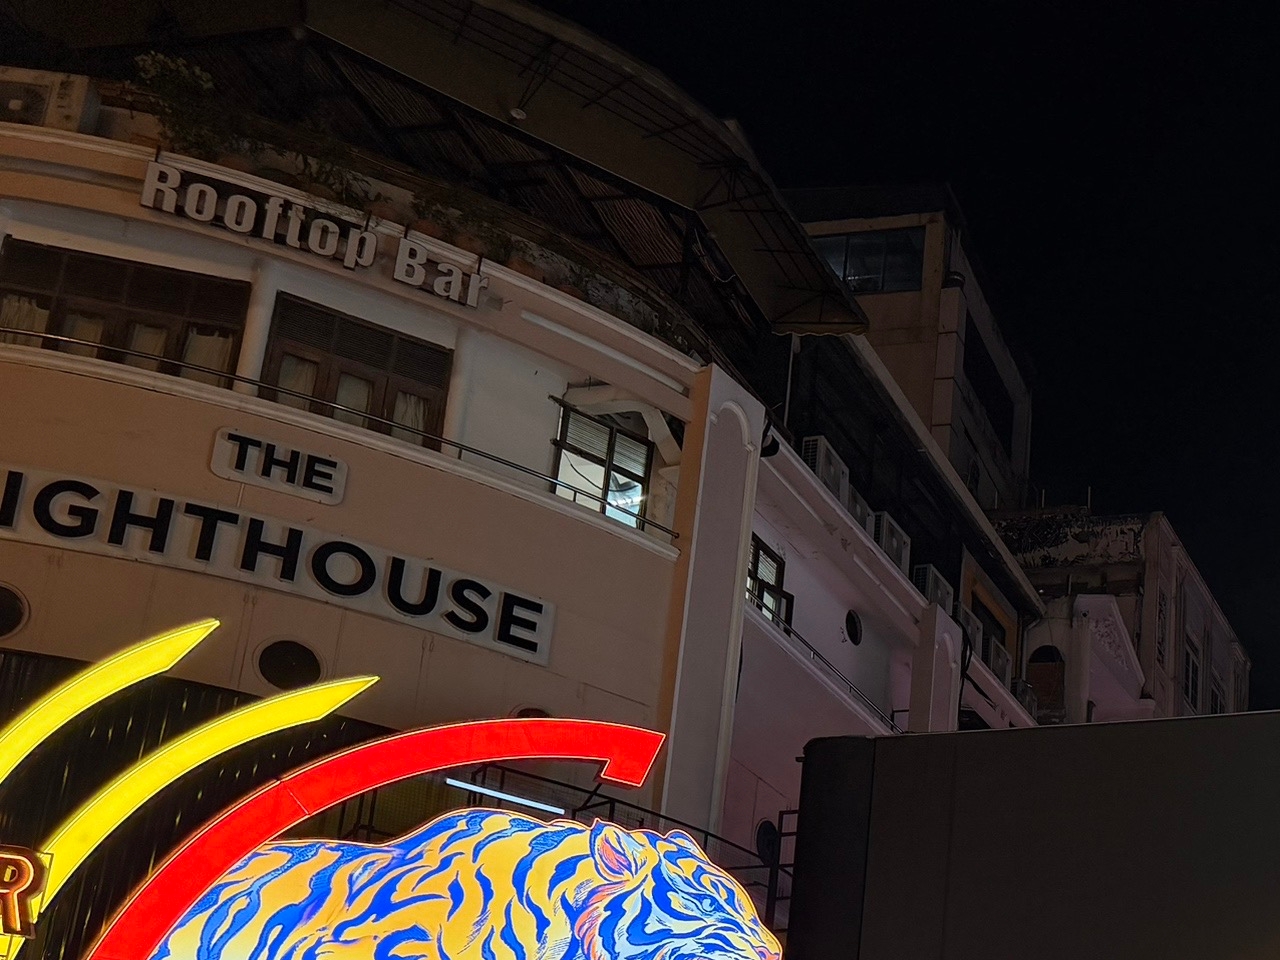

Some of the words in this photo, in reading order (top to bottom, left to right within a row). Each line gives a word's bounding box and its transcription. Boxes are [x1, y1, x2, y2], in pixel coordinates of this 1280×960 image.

[140, 158, 379, 271] Rooftop
[393, 236, 489, 308] Bar
[227, 432, 338, 495] THE
[0, 469, 544, 654] IGHTHOUSE
